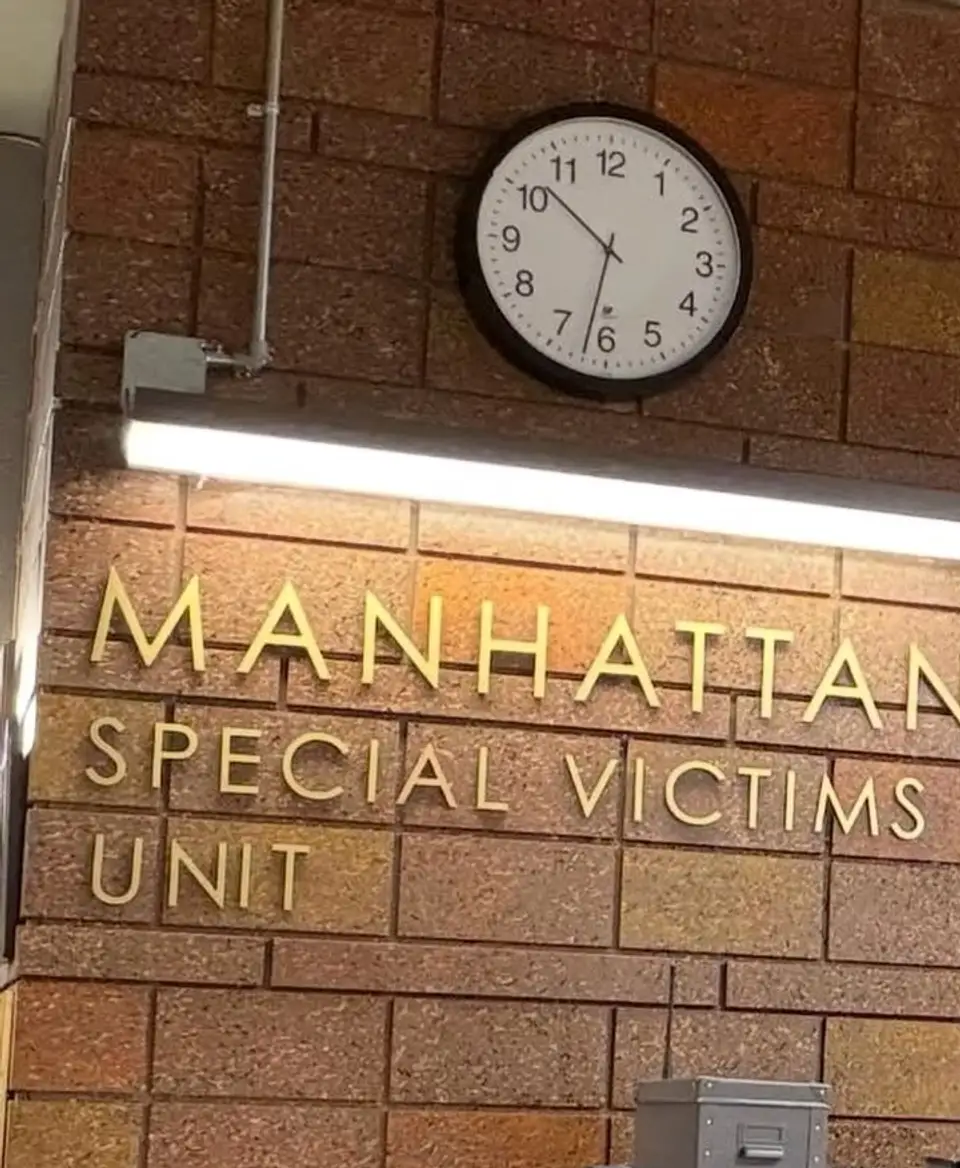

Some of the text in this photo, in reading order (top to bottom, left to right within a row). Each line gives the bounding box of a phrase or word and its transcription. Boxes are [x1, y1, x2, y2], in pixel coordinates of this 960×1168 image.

[550, 155, 576, 184] 11
[596, 149, 626, 178] 12
[654, 171, 665, 196] 1
[517, 184, 549, 213] 10
[680, 207, 699, 233] 2
[502, 225, 521, 252] 9
[695, 251, 714, 277] 3
[515, 269, 534, 297] 8
[679, 291, 698, 317] 4
[553, 309, 572, 335] 7
[643, 320, 662, 347] 5
[597, 326, 616, 353] 6
[85, 716, 926, 841] SPECIAL VICTIMS
[91, 833, 310, 912] UNIT
